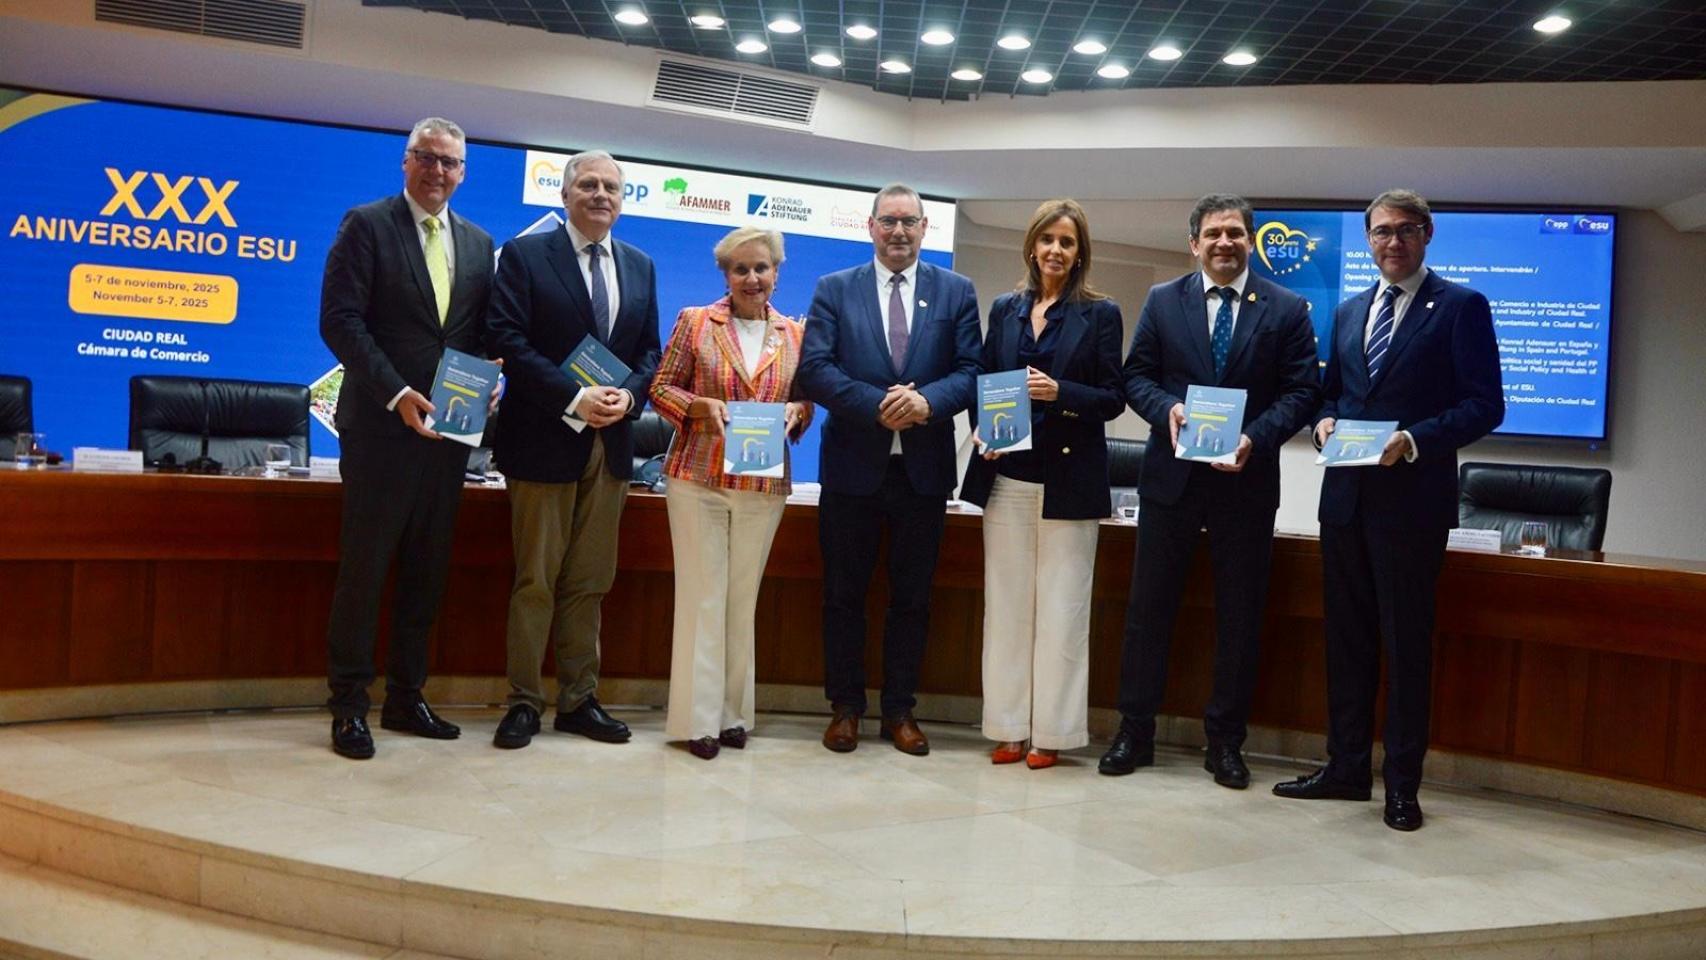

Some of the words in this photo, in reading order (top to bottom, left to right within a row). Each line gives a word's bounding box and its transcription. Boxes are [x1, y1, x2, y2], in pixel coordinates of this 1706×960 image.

[538, 176, 561, 187] esu
[100, 168, 240, 227] XXX
[622, 183, 649, 202] pp
[680, 195, 731, 211] AFAMMER
[771, 196, 803, 206] KONRAD
[771, 204, 813, 215] ADENAUER
[770, 211, 808, 222] STIFTUNG
[1553, 221, 1569, 230] epp
[1590, 222, 1609, 230] esu
[10, 215, 228, 255] ANIVERSARIO
[237, 236, 296, 261] ESU
[1267, 233, 1285, 245] 30
[1266, 246, 1299, 258] esu
[85, 274, 103, 284] 5-7
[107, 276, 121, 286] de
[125, 278, 190, 292] noviembre,
[193, 283, 220, 293] 2025
[93, 291, 153, 304] November
[157, 296, 178, 307] 5-7,
[181, 297, 209, 308] 2025
[1577, 302, 1600, 310] Ciudad
[1546, 309, 1570, 317] Ciudad
[1553, 320, 1577, 328] Ciudad
[103, 328, 154, 343] CIUDAD
[156, 333, 188, 345] REAL
[78, 343, 129, 357] Cámara
[131, 346, 148, 359] de
[150, 348, 210, 363] Comercio
[1557, 397, 1580, 405] Ciudad
